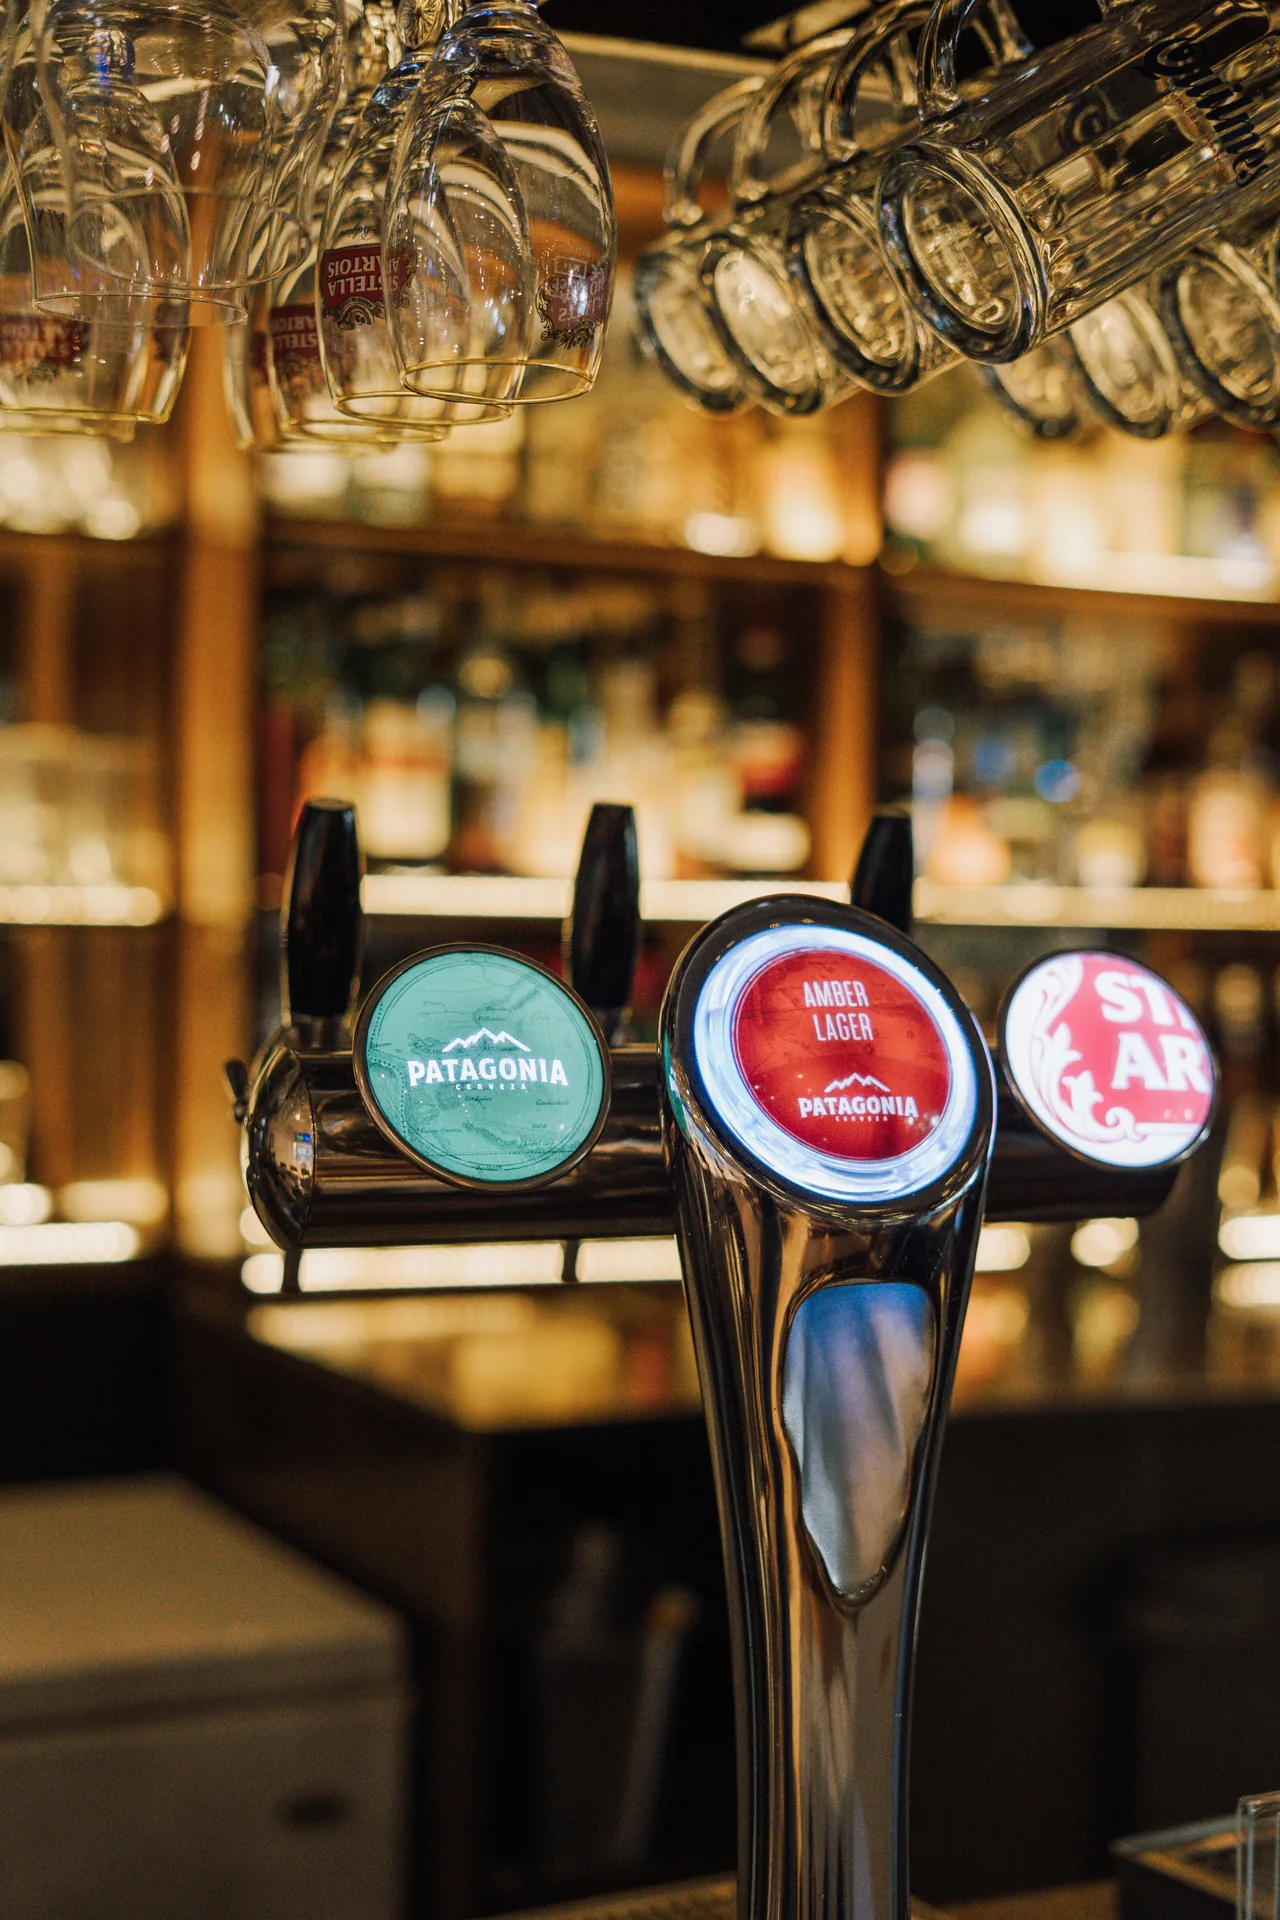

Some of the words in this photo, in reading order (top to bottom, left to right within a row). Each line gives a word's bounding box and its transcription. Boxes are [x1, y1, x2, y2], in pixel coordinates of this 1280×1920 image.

[1131, 38, 1268, 187] Quilmes
[803, 980, 870, 1007] AMBER
[812, 1013, 874, 1041] LAGER
[407, 1058, 568, 1087] PATAGONIA
[455, 1083, 527, 1091] CERVEZA
[797, 1096, 919, 1118] PATAGONIA
